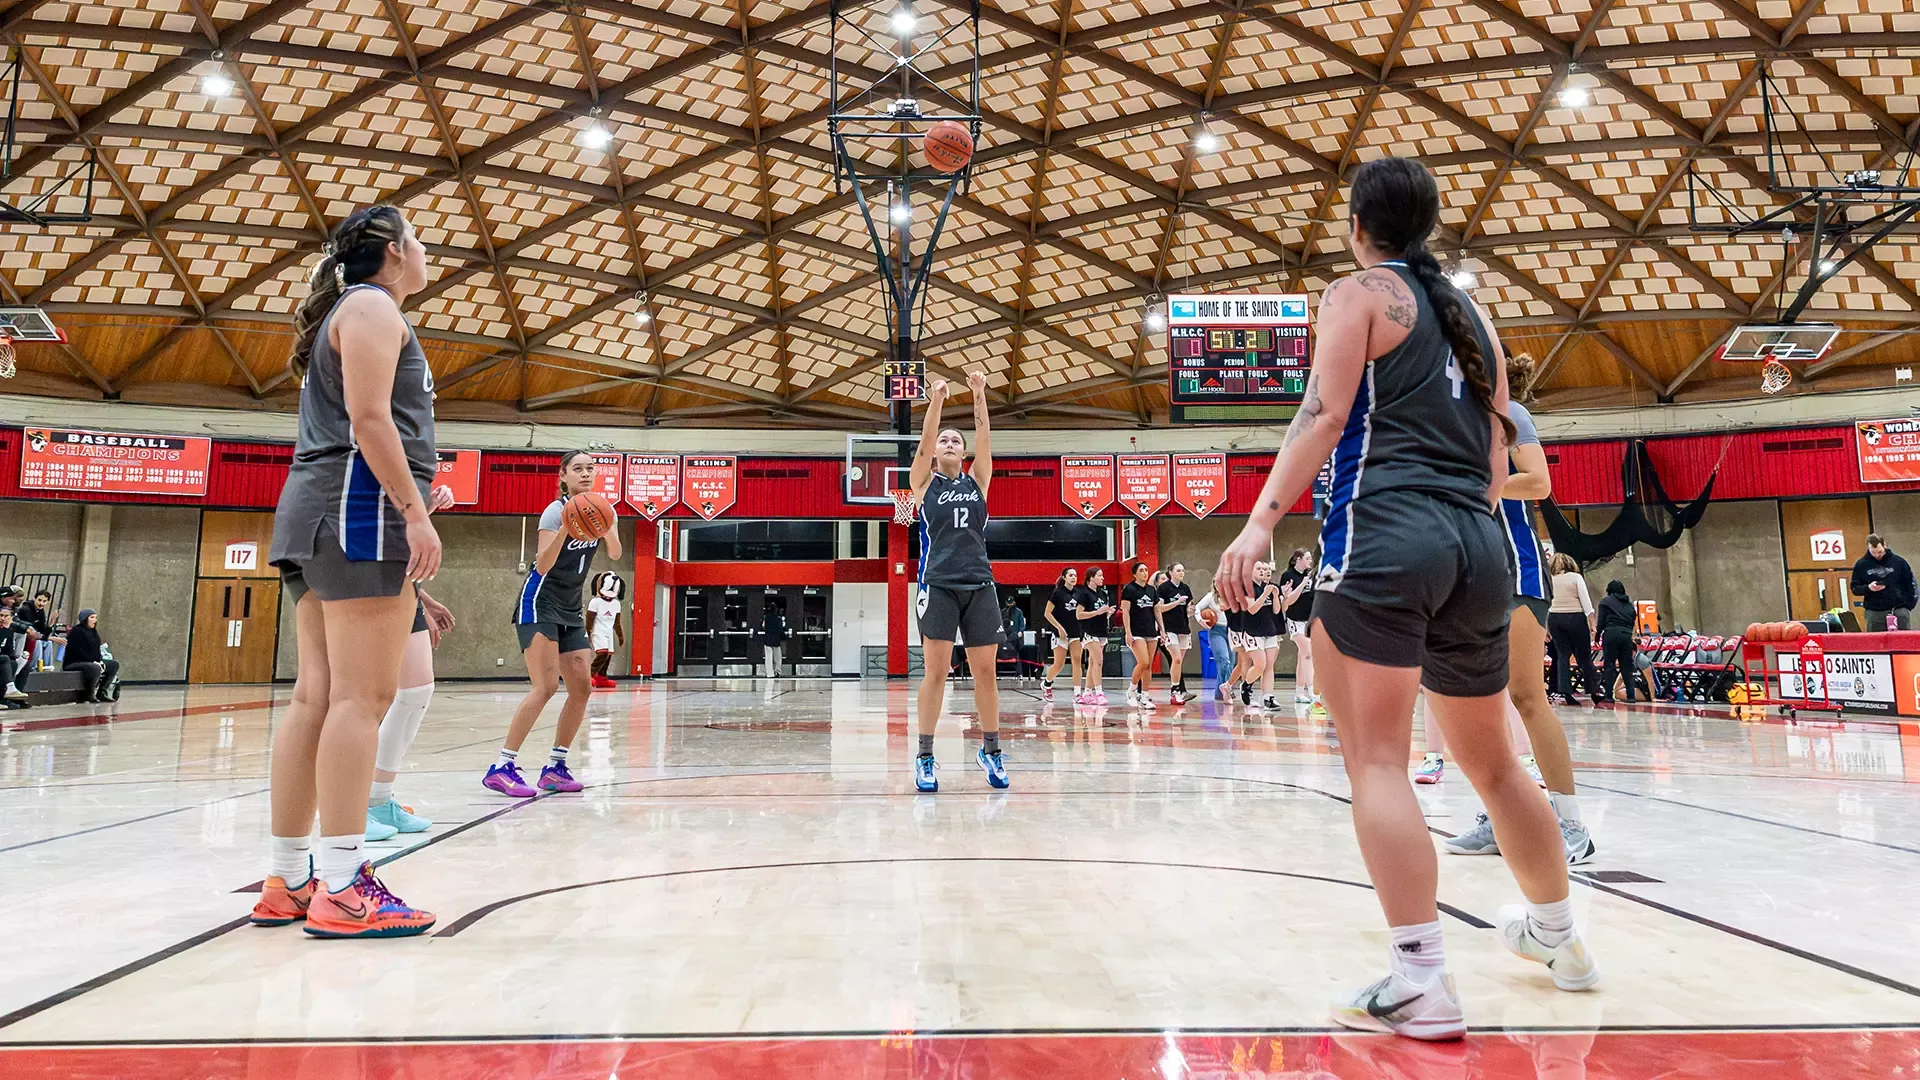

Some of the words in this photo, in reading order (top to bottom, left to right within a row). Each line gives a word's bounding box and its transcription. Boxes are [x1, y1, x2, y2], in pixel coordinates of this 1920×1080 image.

[1198, 301, 1219, 317] HOME
[1223, 301, 1232, 317] OF
[1235, 301, 1249, 317] THE
[1252, 301, 1278, 317] SAINTS
[1171, 328, 1204, 337] M.H.C.C.
[1276, 328, 1307, 336] VISITOR
[891, 378, 917, 398] 30
[68, 434, 169, 448] BASEBALL
[1889, 434, 1920, 446] CH
[53, 444, 180, 461] CHAMPIONS
[594, 466, 619, 476] PIONS
[629, 465, 676, 474] CHAMPIONS
[686, 469, 733, 478] CHAMPIONS
[1064, 469, 1110, 478] CHAMPIONS
[1120, 468, 1166, 477] CHAMPIONS
[1177, 467, 1222, 476] CHAMPIONS
[937, 490, 980, 505] Clark
[953, 507, 969, 528] 12
[1815, 540, 1842, 554] 126
[232, 550, 251, 563] 117
[578, 554, 586, 574] 1
[1792, 658, 1816, 672] LE'S
[1836, 658, 1875, 674] SAINTS!
